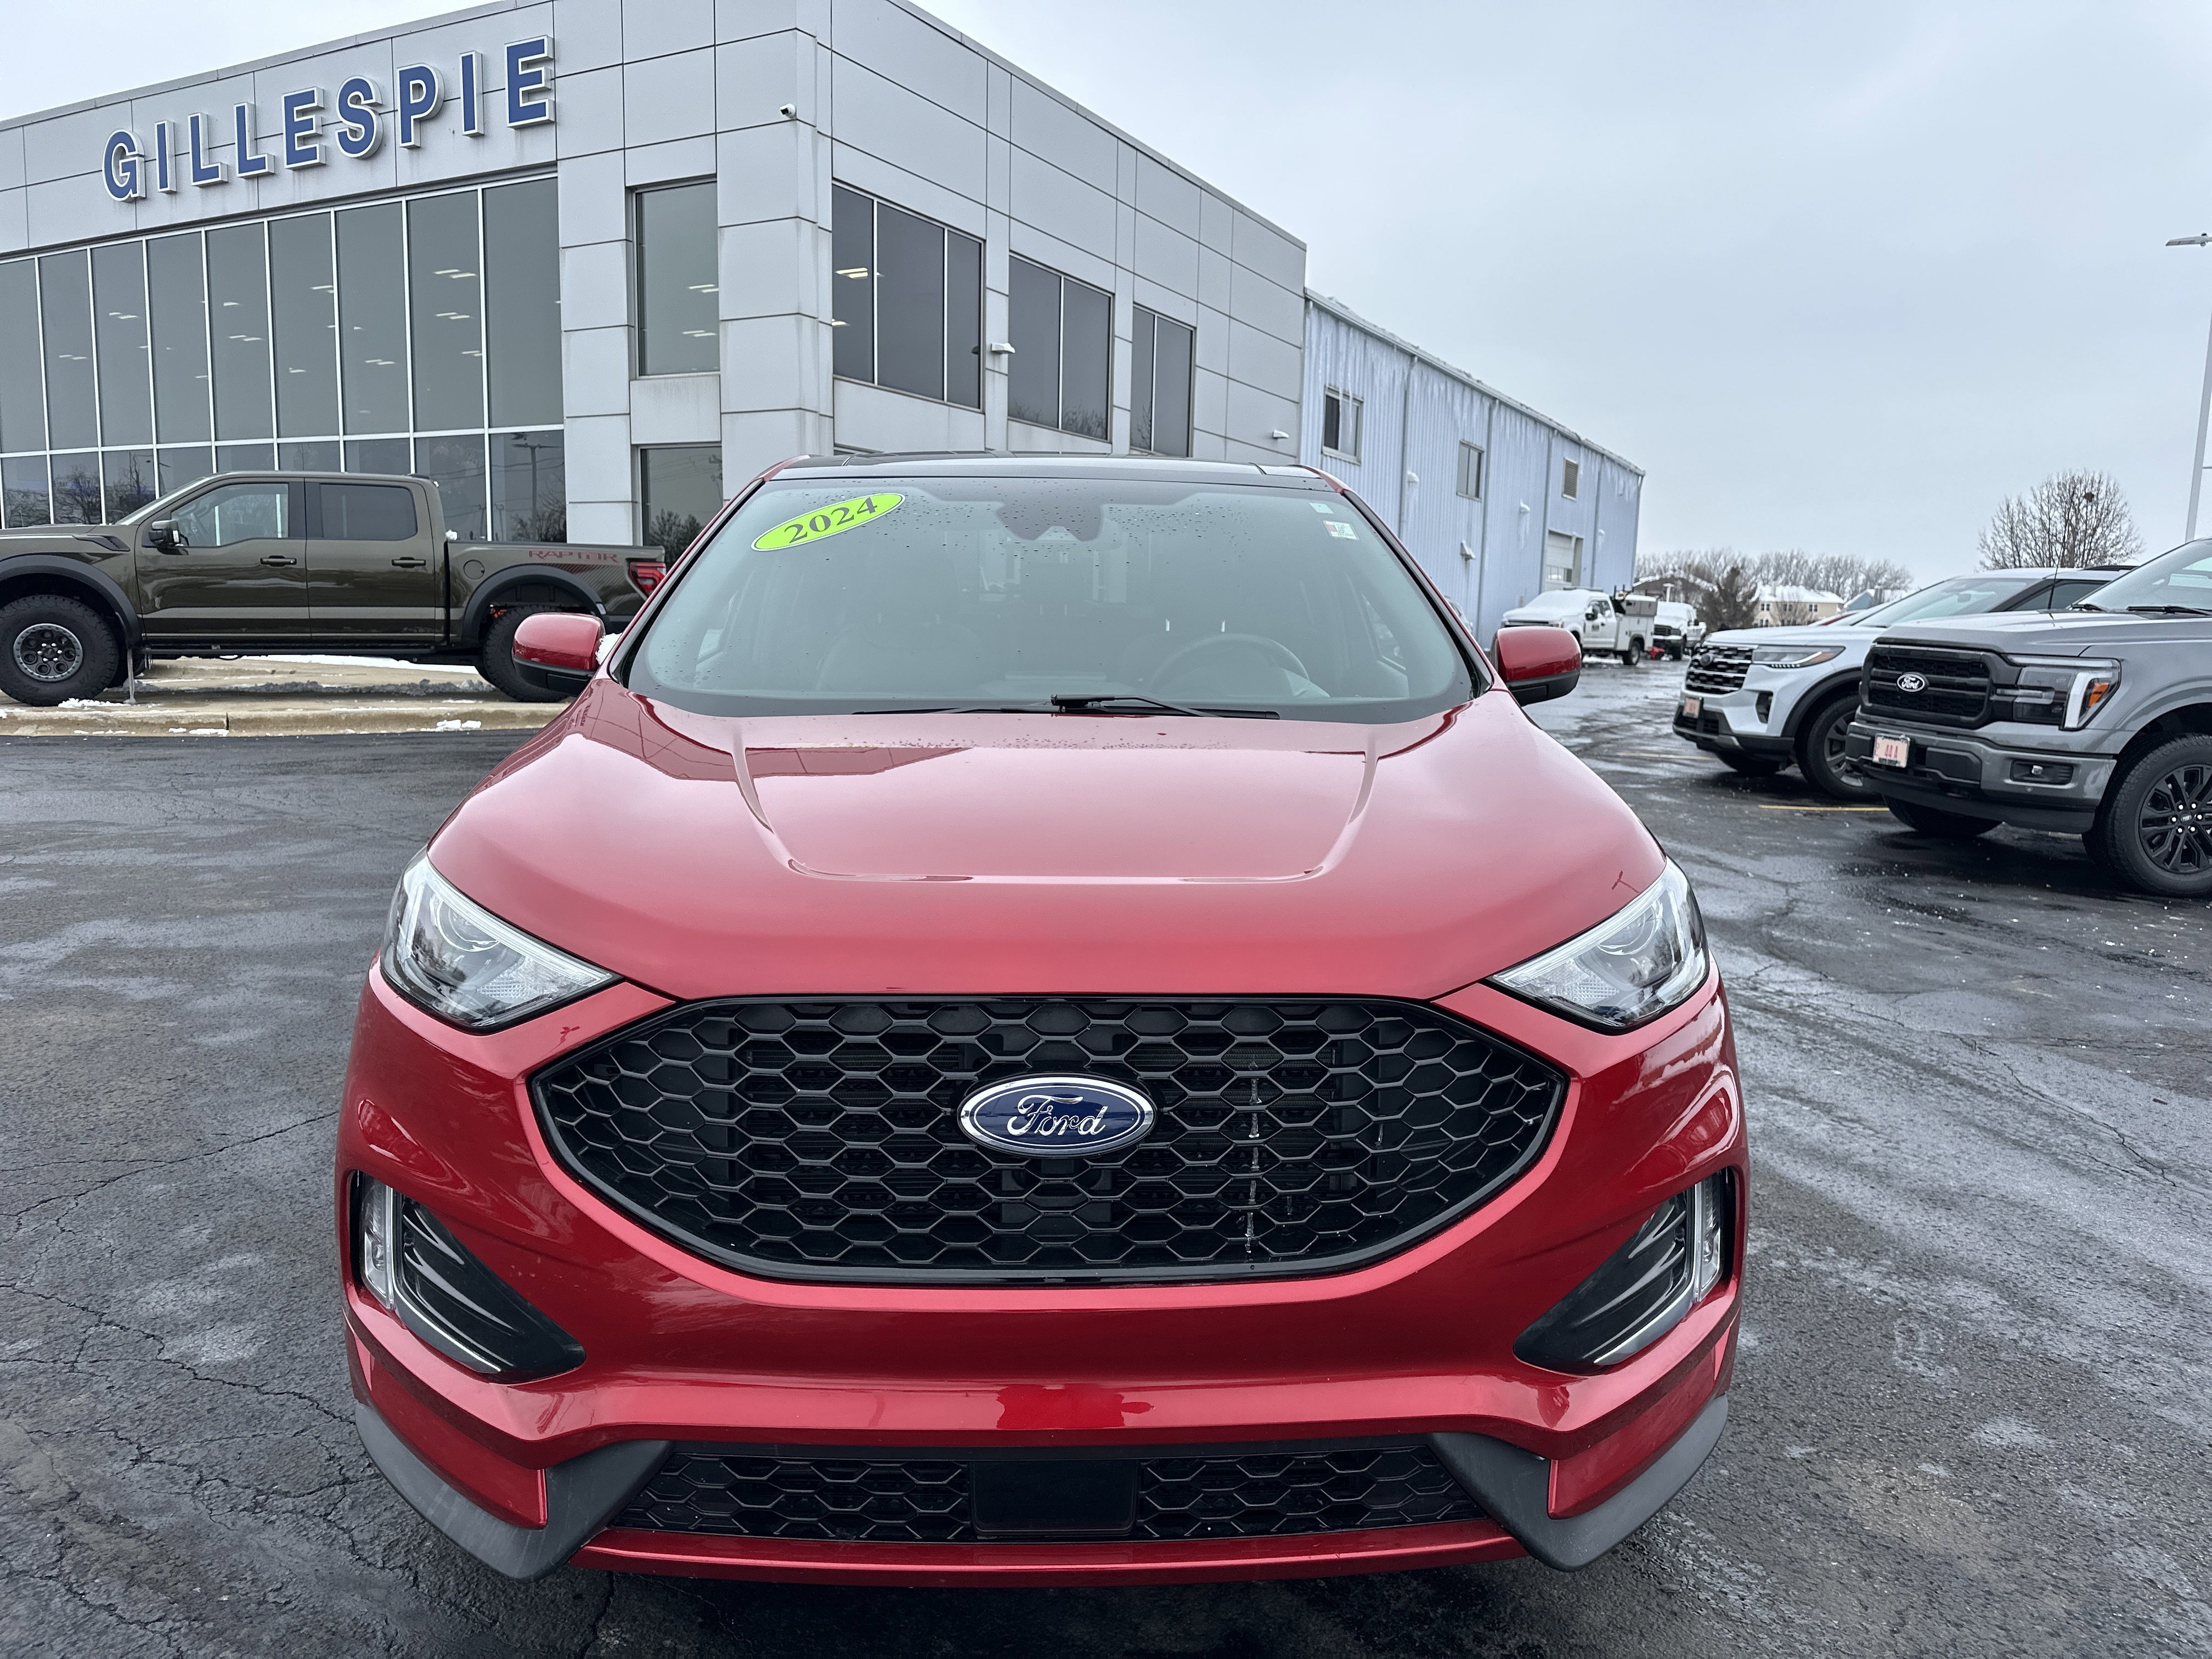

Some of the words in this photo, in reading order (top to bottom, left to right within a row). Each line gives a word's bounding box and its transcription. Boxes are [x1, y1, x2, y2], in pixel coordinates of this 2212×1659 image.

[102, 35, 555, 202] GILLESPIE
[784, 497, 877, 543] 2024
[528, 550, 622, 565] RAPTOR
[1901, 676, 1920, 689] Ford
[1007, 1094, 1108, 1136] Ford
